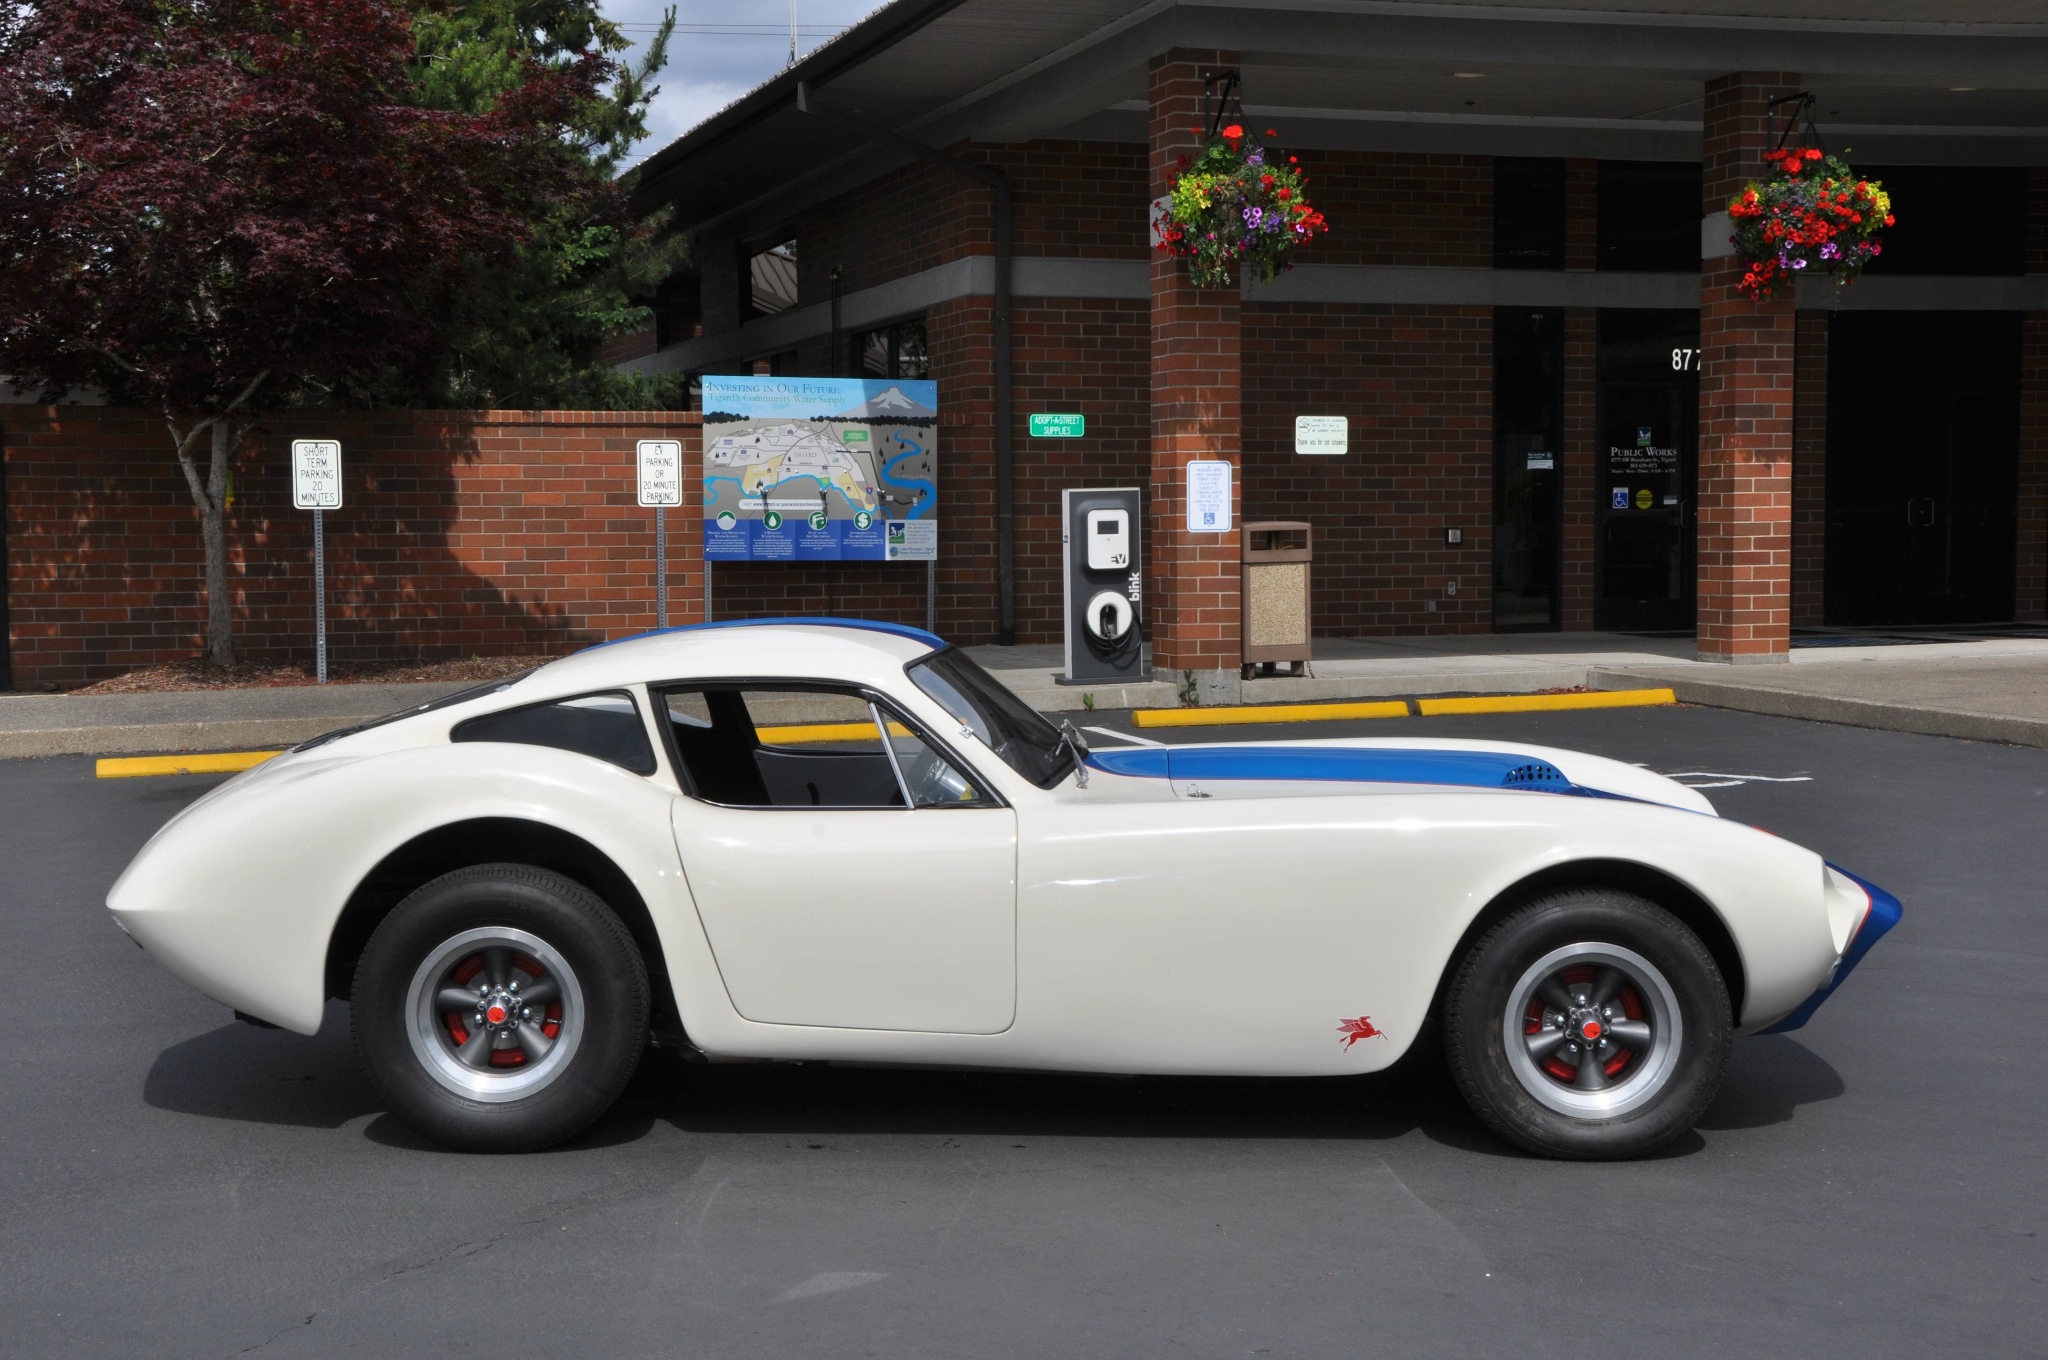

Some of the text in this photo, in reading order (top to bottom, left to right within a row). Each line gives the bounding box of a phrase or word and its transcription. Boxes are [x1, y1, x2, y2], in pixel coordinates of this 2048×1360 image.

[708, 382, 760, 392] INVESTING
[776, 383, 799, 393] OUR
[803, 384, 840, 394] FUTURE
[709, 393, 740, 402] Tigard's
[743, 394, 790, 403] Community
[819, 395, 845, 406] Supply
[1034, 416, 1080, 424] ADOPT-A-STREET
[1044, 426, 1071, 434] SUPPLIES
[304, 447, 328, 456] SHORT
[655, 446, 663, 455] EV
[1611, 447, 1677, 456] PUBLIC WORKS
[307, 458, 327, 468] TERM
[646, 458, 673, 467] PARKING
[301, 470, 333, 479] PARKING
[655, 470, 664, 478] OR
[312, 481, 322, 490] 20
[643, 481, 676, 489] 20 MINUTE
[302, 493, 334, 502] MINUTES
[647, 492, 673, 501] PARKING
[1129, 572, 1140, 602] blink
